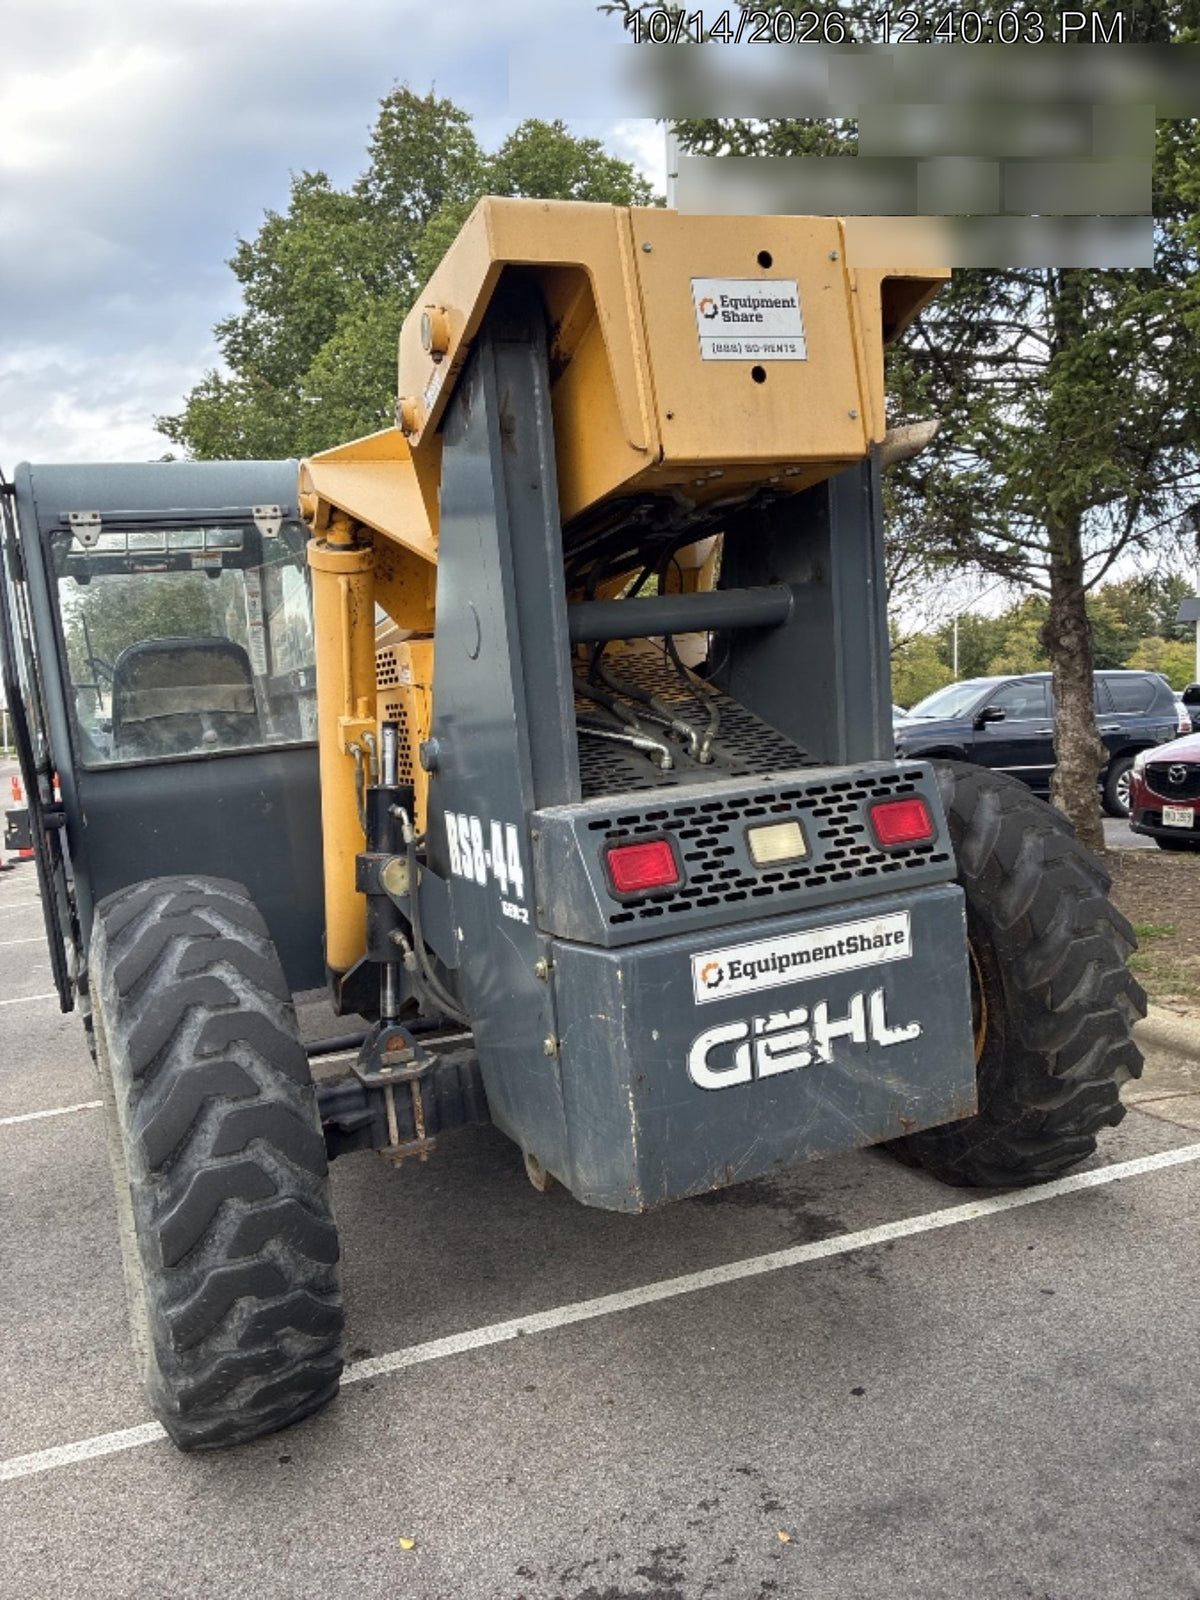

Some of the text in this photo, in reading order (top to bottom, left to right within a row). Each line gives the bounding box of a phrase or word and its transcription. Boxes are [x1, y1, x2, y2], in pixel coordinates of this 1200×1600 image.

[719, 295, 797, 311] Equipment
[721, 310, 764, 323] Share
[712, 343, 742, 354] (888)
[727, 929, 906, 981] EquipmentShare
[687, 986, 923, 1092] GEHL
